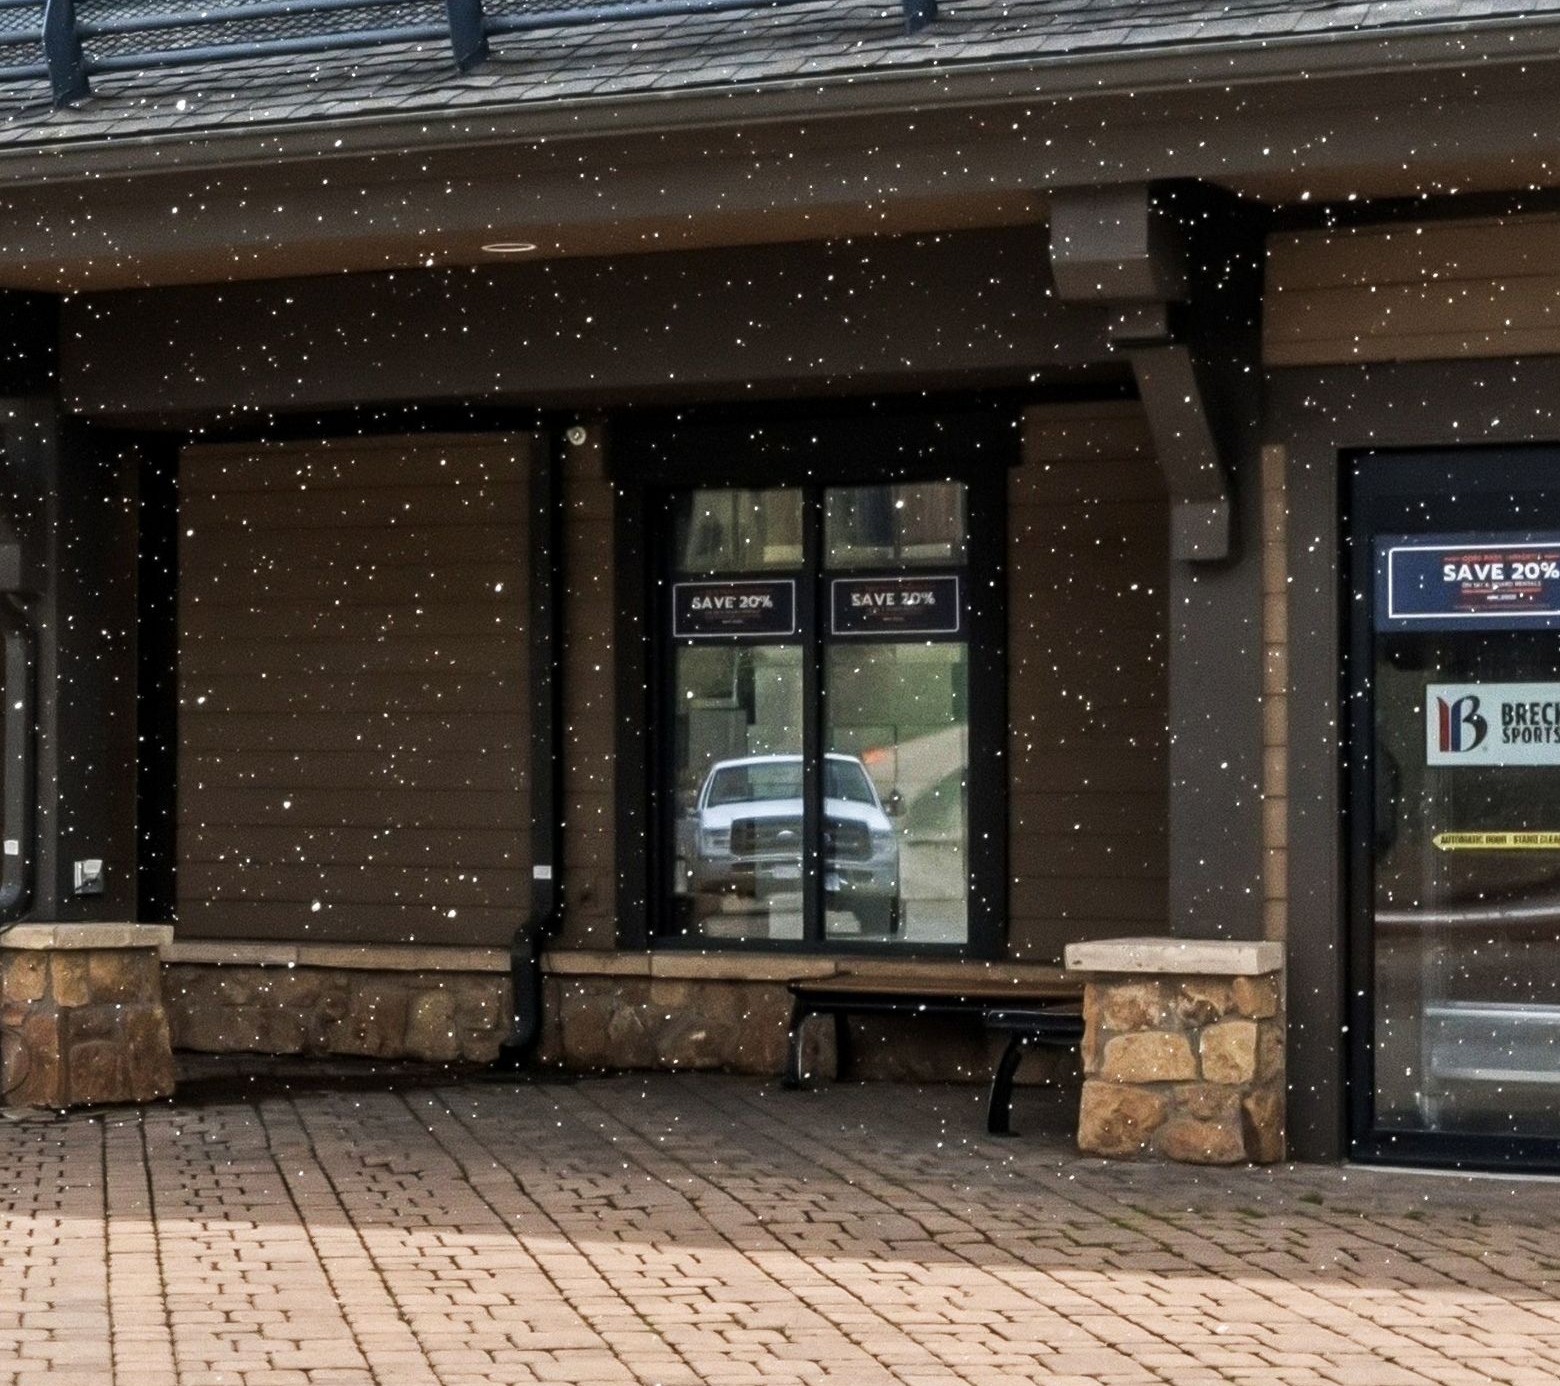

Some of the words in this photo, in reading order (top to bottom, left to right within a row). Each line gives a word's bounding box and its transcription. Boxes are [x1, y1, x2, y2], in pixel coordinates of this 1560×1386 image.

[1443, 563, 1504, 581] SAVE
[1511, 562, 1560, 580] 20%
[692, 596, 733, 610] SAVE
[739, 595, 773, 609] 20%
[851, 593, 894, 607] SAVE
[899, 591, 936, 605] 20%
